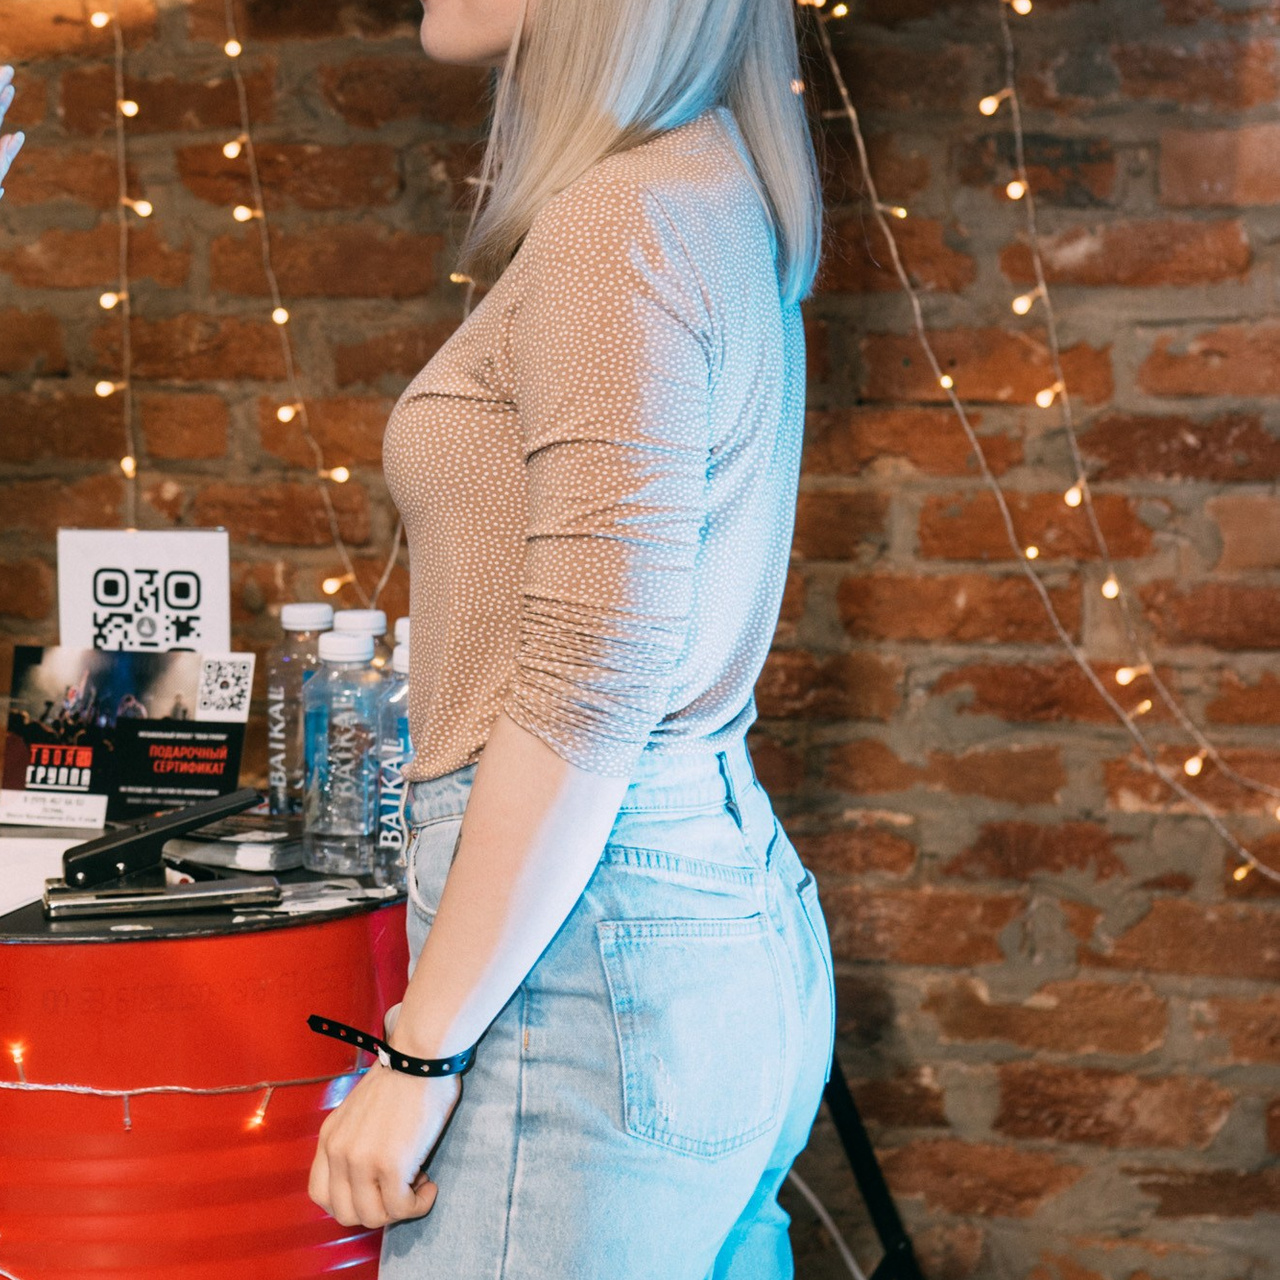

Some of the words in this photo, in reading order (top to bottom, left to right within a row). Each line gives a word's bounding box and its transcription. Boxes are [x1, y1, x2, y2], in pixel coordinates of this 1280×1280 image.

[148, 744, 228, 760] ПОДАРОЧНЫЙ
[268, 686, 287, 788] BAIKAL
[153, 760, 226, 775] СЕРТИФИКАТ
[379, 738, 405, 849] BAIKAL
